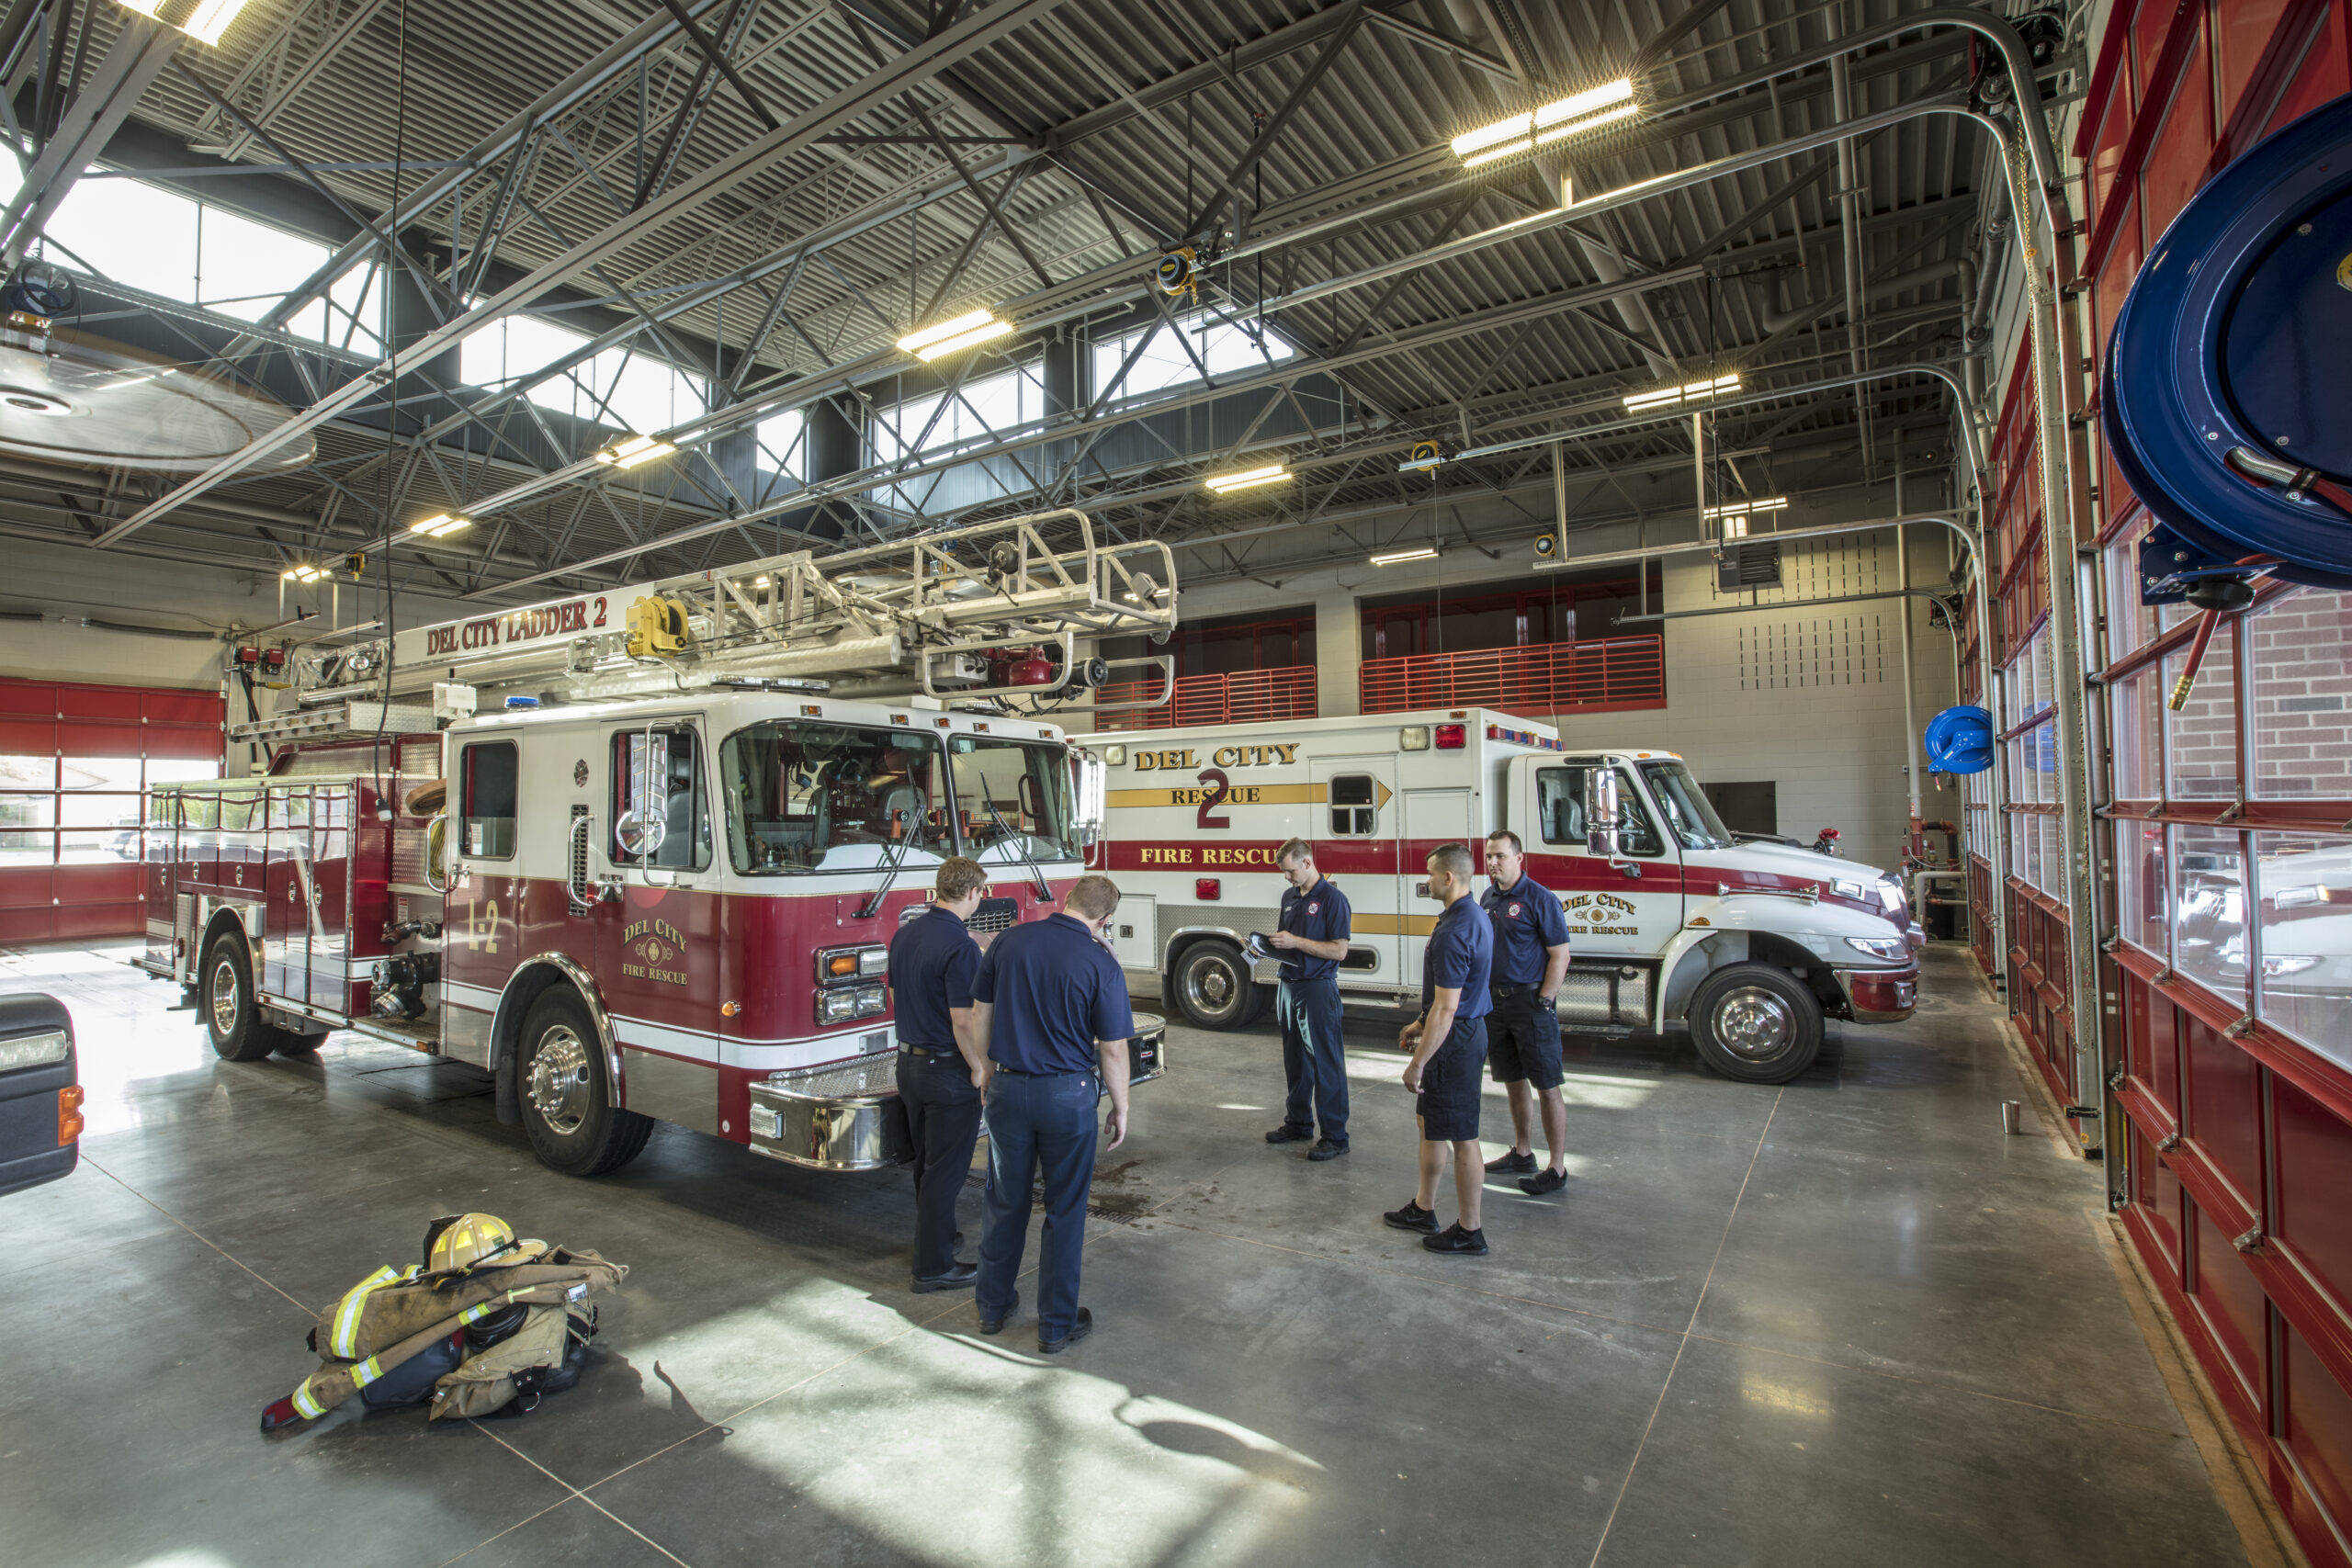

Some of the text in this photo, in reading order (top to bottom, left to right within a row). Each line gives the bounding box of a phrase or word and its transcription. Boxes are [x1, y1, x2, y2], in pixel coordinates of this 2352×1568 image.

[427, 597, 607, 656] DEL CITY LADDER 2
[1135, 743, 1300, 771] DEL CITY
[1170, 788, 1260, 804] RESCUE
[1197, 768, 1230, 829] 2
[1140, 849, 1278, 864] FIRE RESCU
[1562, 893, 1636, 915] DEL CITY
[469, 898, 498, 953] L-2
[624, 919, 686, 953] DEL CITY
[1567, 925, 1638, 935] IRE RESCUE
[622, 964, 687, 986] FIRE RESCUE
